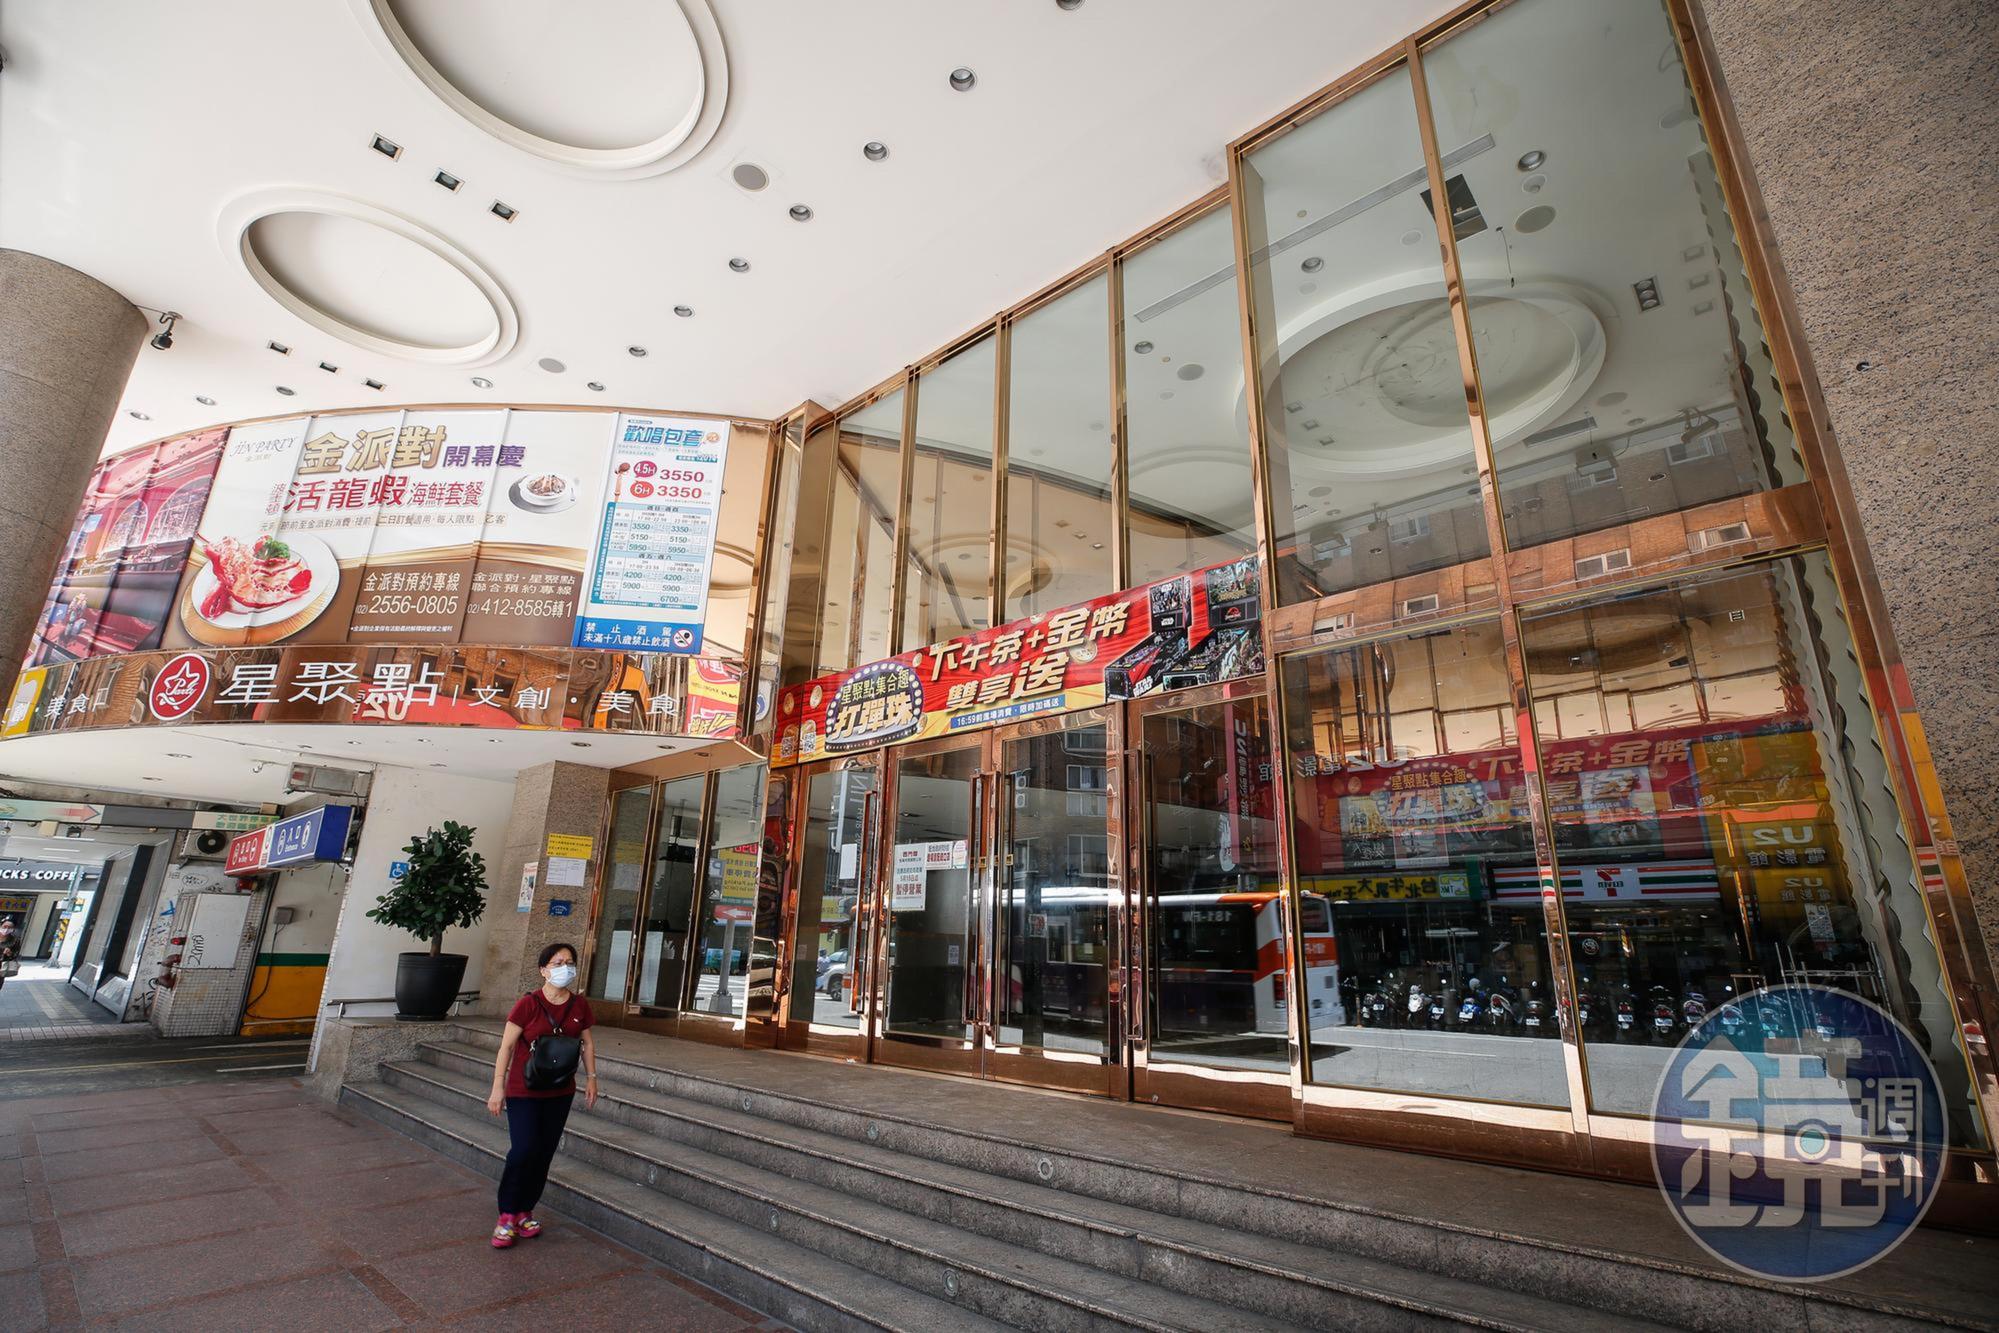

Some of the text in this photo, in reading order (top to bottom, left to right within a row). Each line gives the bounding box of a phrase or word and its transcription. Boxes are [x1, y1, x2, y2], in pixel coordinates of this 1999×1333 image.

[298, 424, 527, 474] 金派對 開幕慶
[283, 474, 485, 512] 活龍蝦 海鮮套餐
[657, 485, 703, 499] 3350
[660, 469, 704, 483] 3550
[363, 572, 461, 592] 金派對預約專線
[369, 595, 458, 614] 2556-0805
[214, 662, 445, 707] 星聚點
[841, 668, 910, 705] 星聚點集合趣
[945, 652, 1069, 713] 雙享送
[831, 692, 914, 740] 打彈珠
[0, 869, 29, 880] CKS
